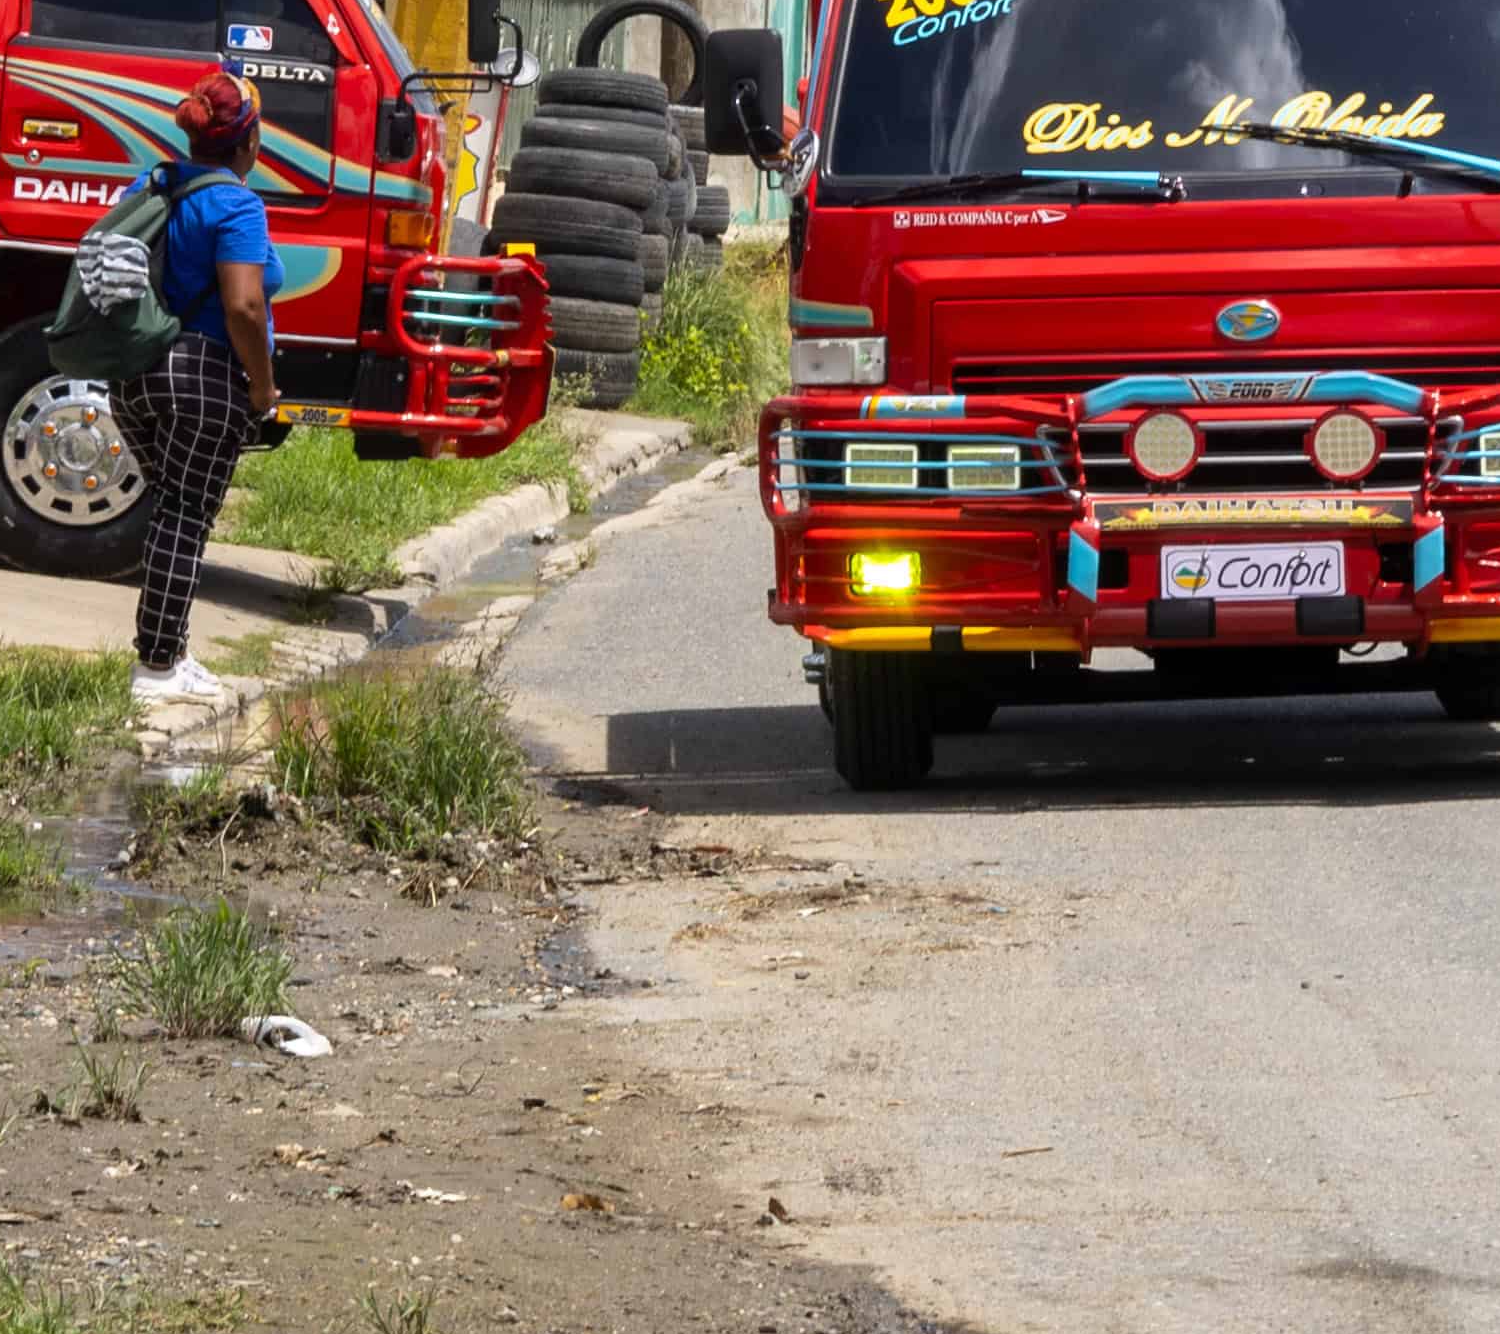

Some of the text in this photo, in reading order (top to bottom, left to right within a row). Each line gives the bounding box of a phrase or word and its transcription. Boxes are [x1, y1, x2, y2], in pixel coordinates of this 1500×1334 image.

[242, 63, 327, 84] DELTA
[1023, 102, 1154, 155] Dios
[1270, 90, 1447, 147] Olvida
[13, 175, 125, 208] DAIHA
[912, 213, 937, 227] REID
[937, 214, 946, 227] &
[1004, 211, 1014, 225] C
[1013, 213, 1029, 227] por
[1029, 210, 1039, 224] A
[1229, 382, 1274, 399] 2006
[300, 407, 328, 424] 2005
[1151, 498, 1355, 522] DAIHATSU
[1217, 555, 1333, 591] Confort
